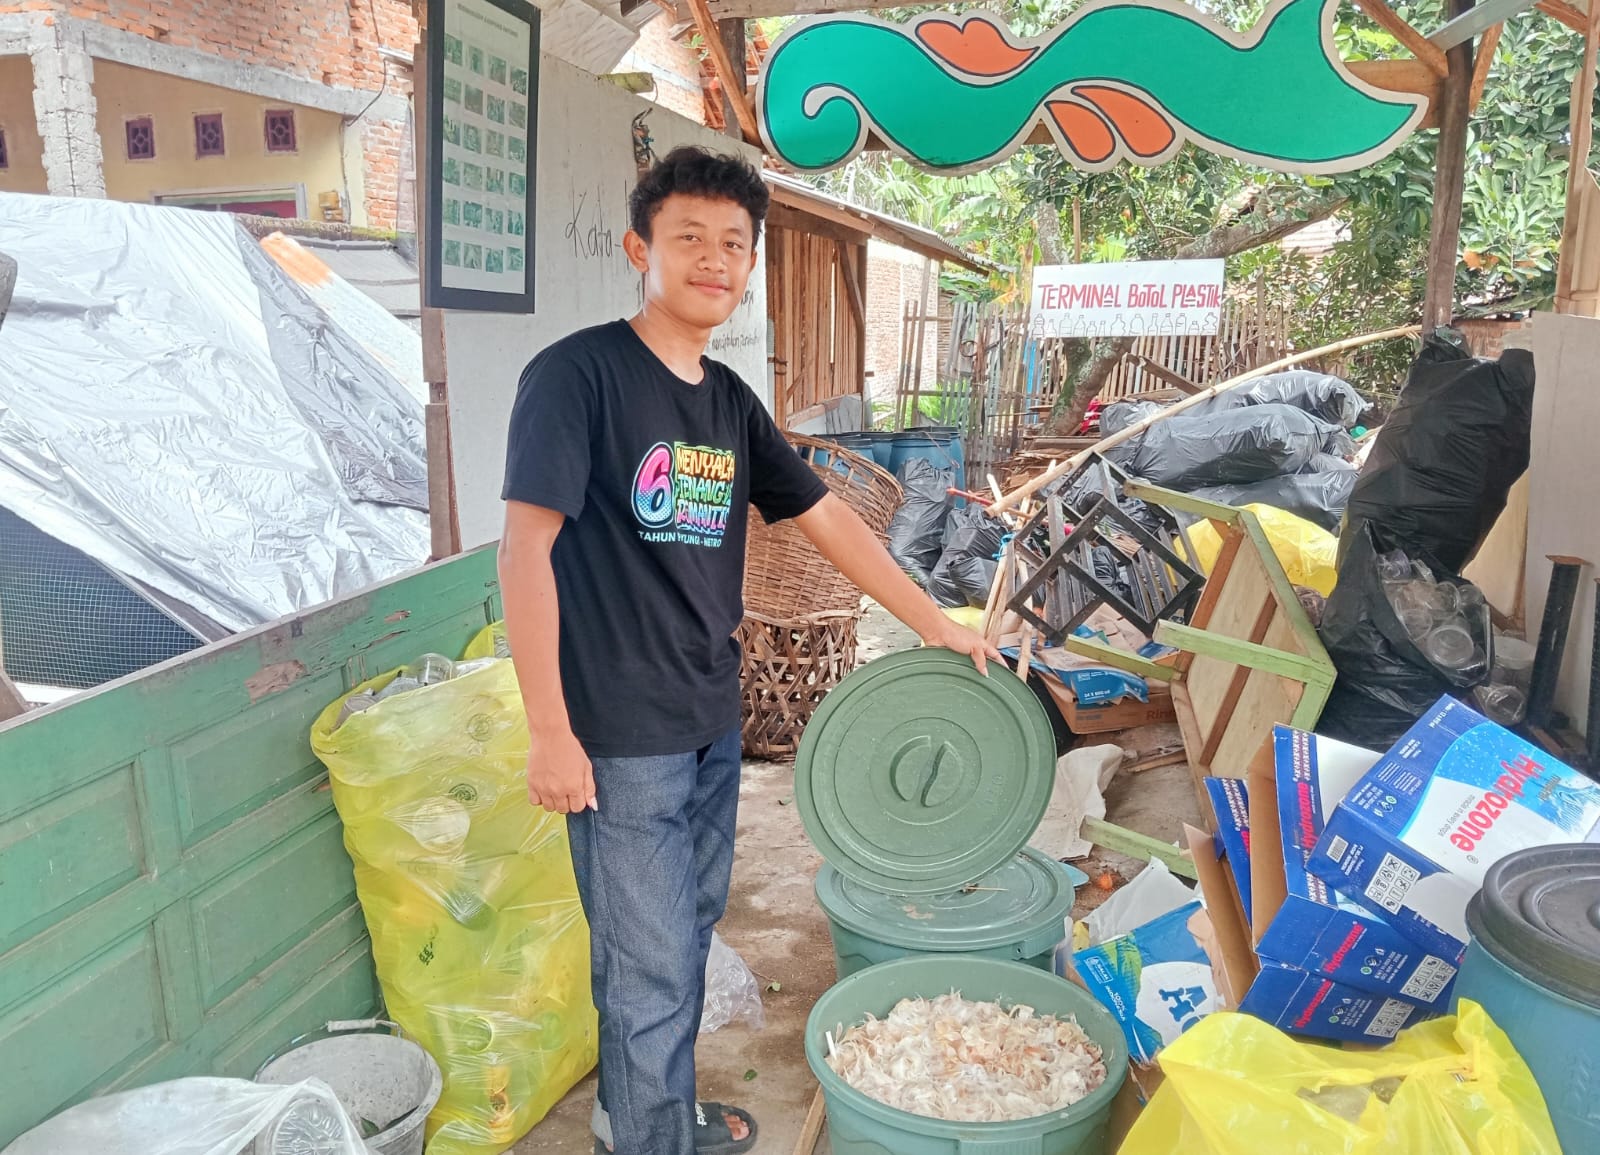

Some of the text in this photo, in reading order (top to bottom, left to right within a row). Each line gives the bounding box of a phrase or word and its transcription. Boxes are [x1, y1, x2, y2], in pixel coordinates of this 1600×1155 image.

[1038, 284, 1121, 310] TERMINAL
[632, 442, 674, 528] 6
[637, 530, 676, 543] TAHUN
[1450, 752, 1546, 852] Hydrozone
